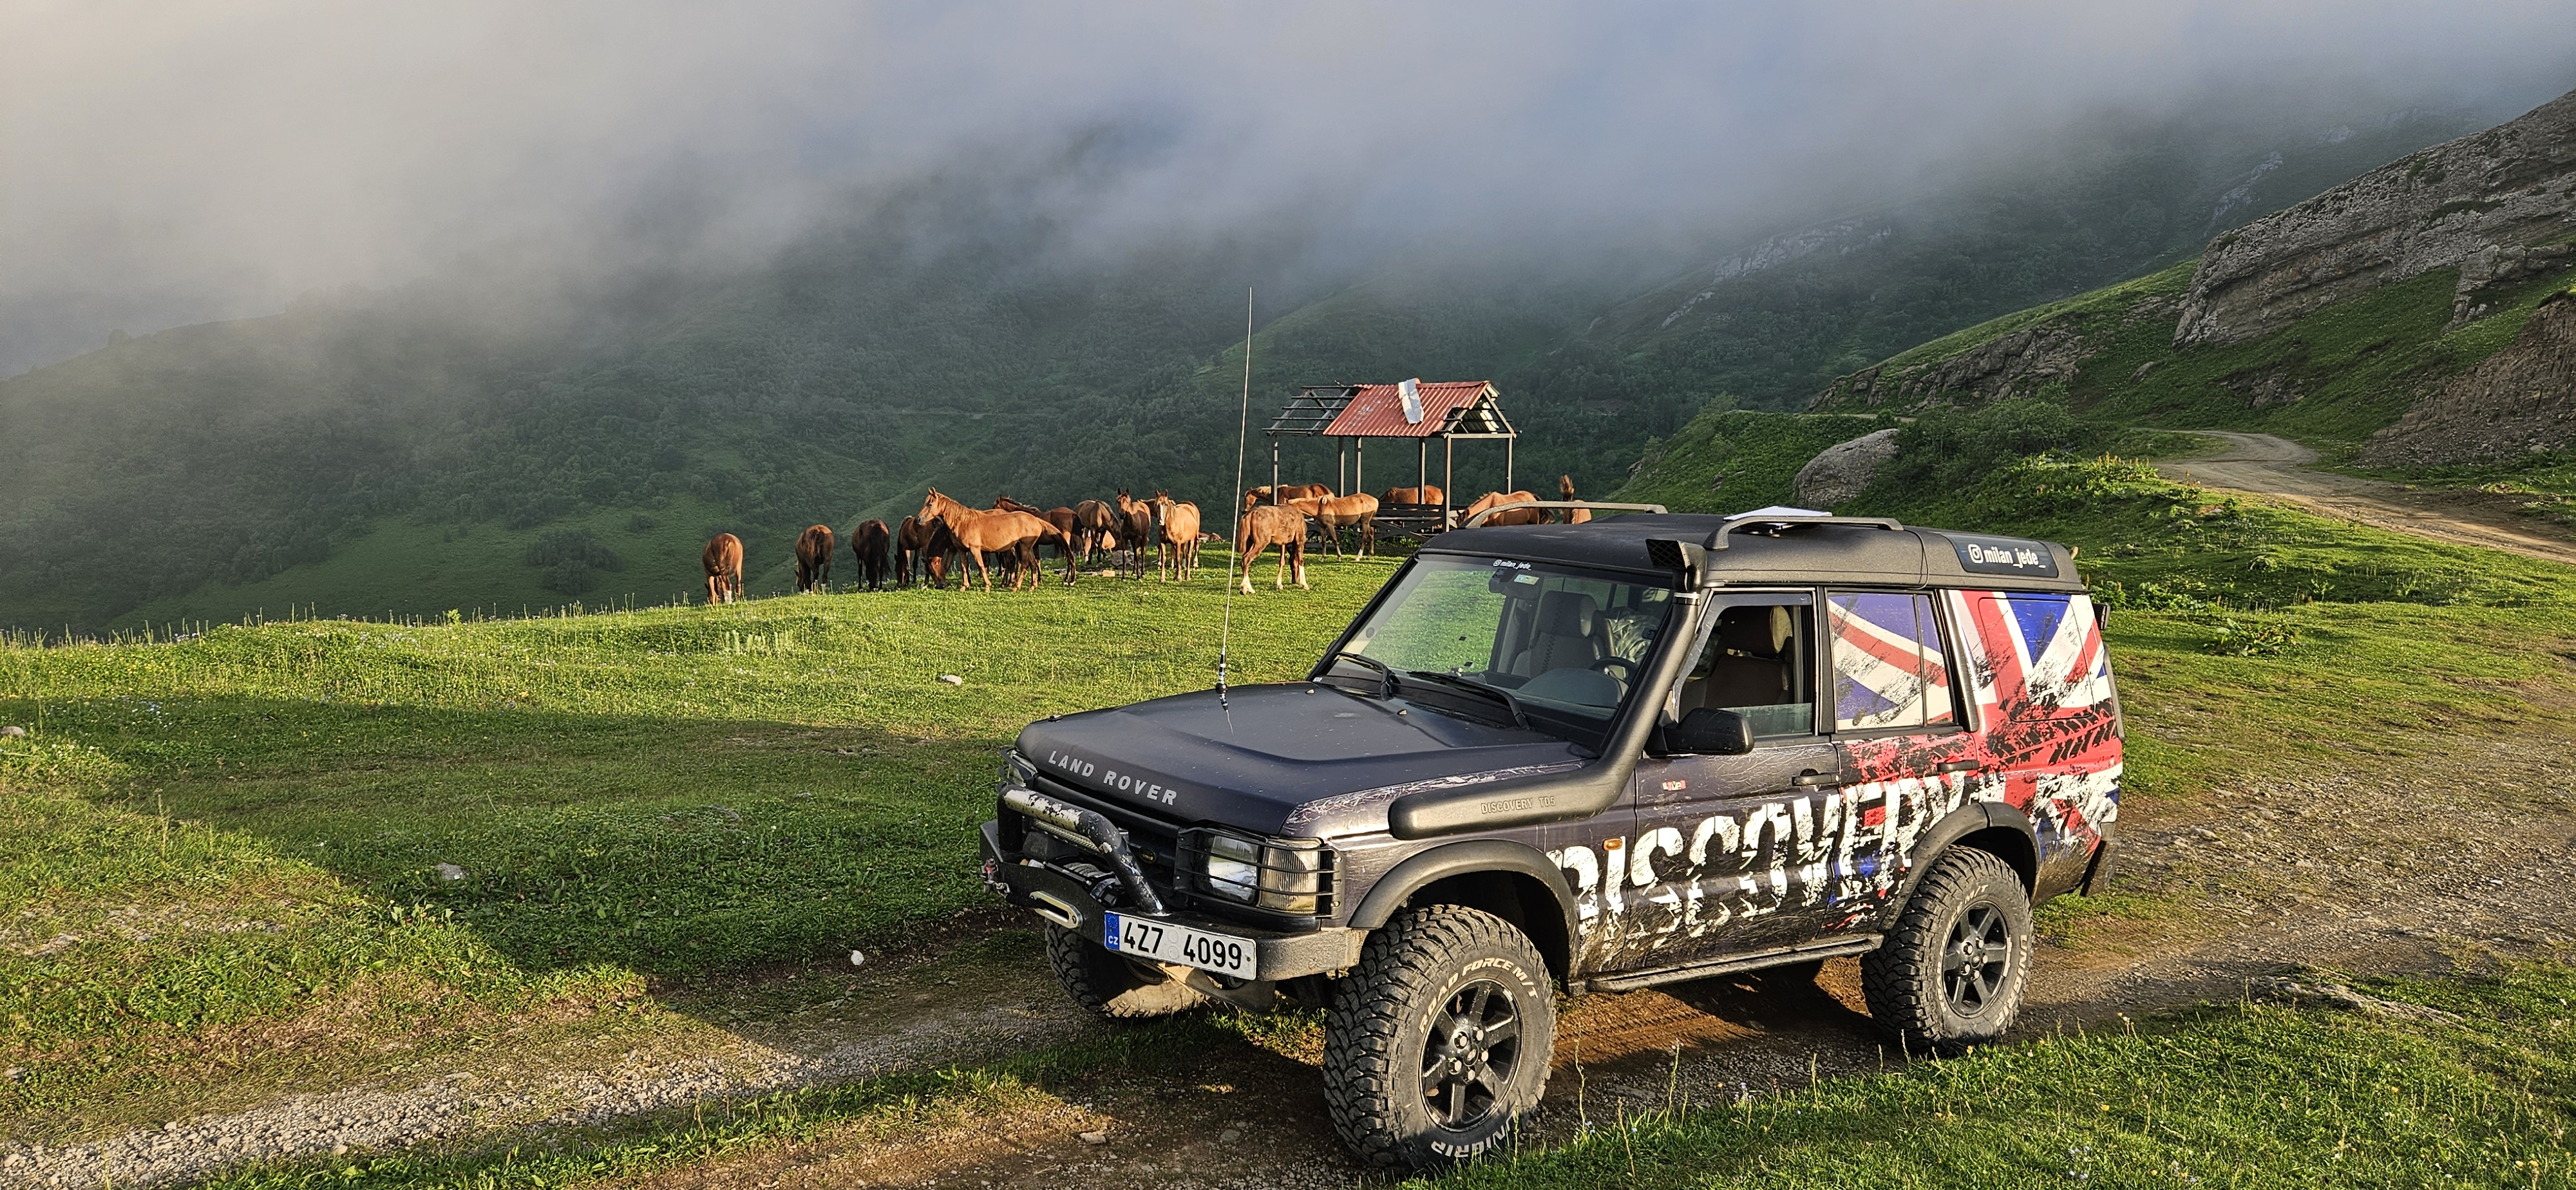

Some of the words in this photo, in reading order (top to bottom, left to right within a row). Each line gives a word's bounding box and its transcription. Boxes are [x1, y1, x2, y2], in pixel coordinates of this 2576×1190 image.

[1984, 546, 2046, 569] milan_jede_
[1048, 750, 1094, 777] LAND
[1103, 770, 1177, 806] ROVER
[1481, 798, 1532, 814] DISCOVERY
[1539, 796, 1555, 807] TD5
[1965, 885, 1989, 904] M/T
[1108, 935, 1119, 945] CZ
[1124, 921, 1164, 954] 4Z7
[1183, 934, 1242, 970] 4099
[1419, 972, 1459, 1034] ROAD
[1462, 958, 1514, 977] FORCE
[1512, 967, 1539, 999] M/T
[1996, 934, 2027, 1026] UNIGRIP
[1431, 1110, 1517, 1157] UNIGRIP
